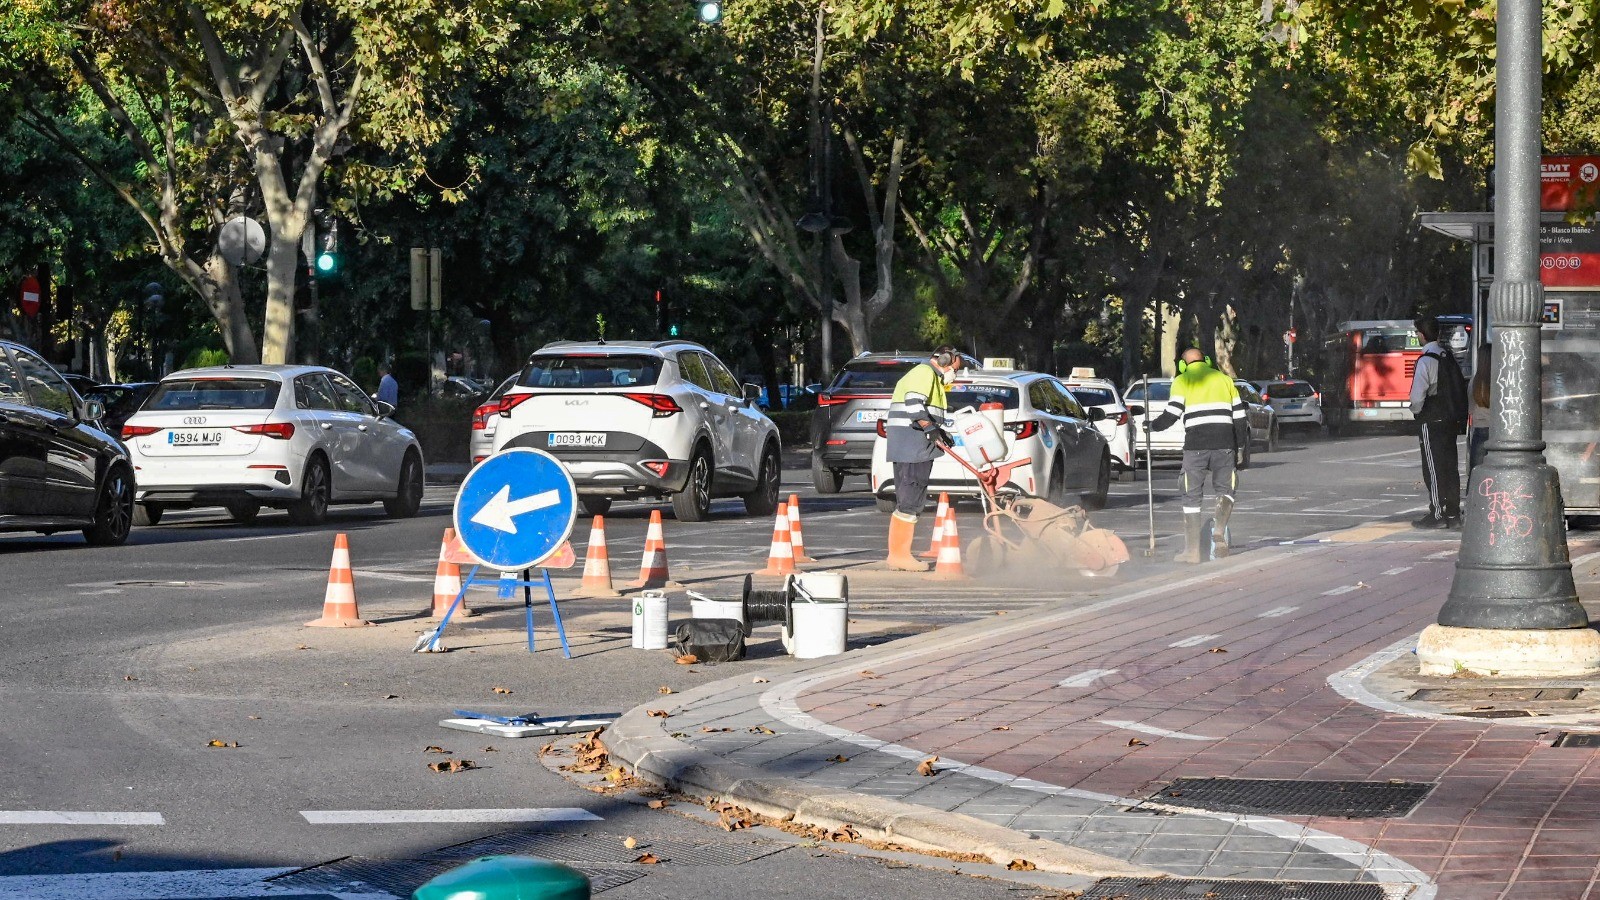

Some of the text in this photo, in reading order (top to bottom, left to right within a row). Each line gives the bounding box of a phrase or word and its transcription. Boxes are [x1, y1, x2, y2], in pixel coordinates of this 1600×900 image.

[174, 433, 222, 442] 9594 MJG
[557, 435, 604, 443] 0093 MCK
